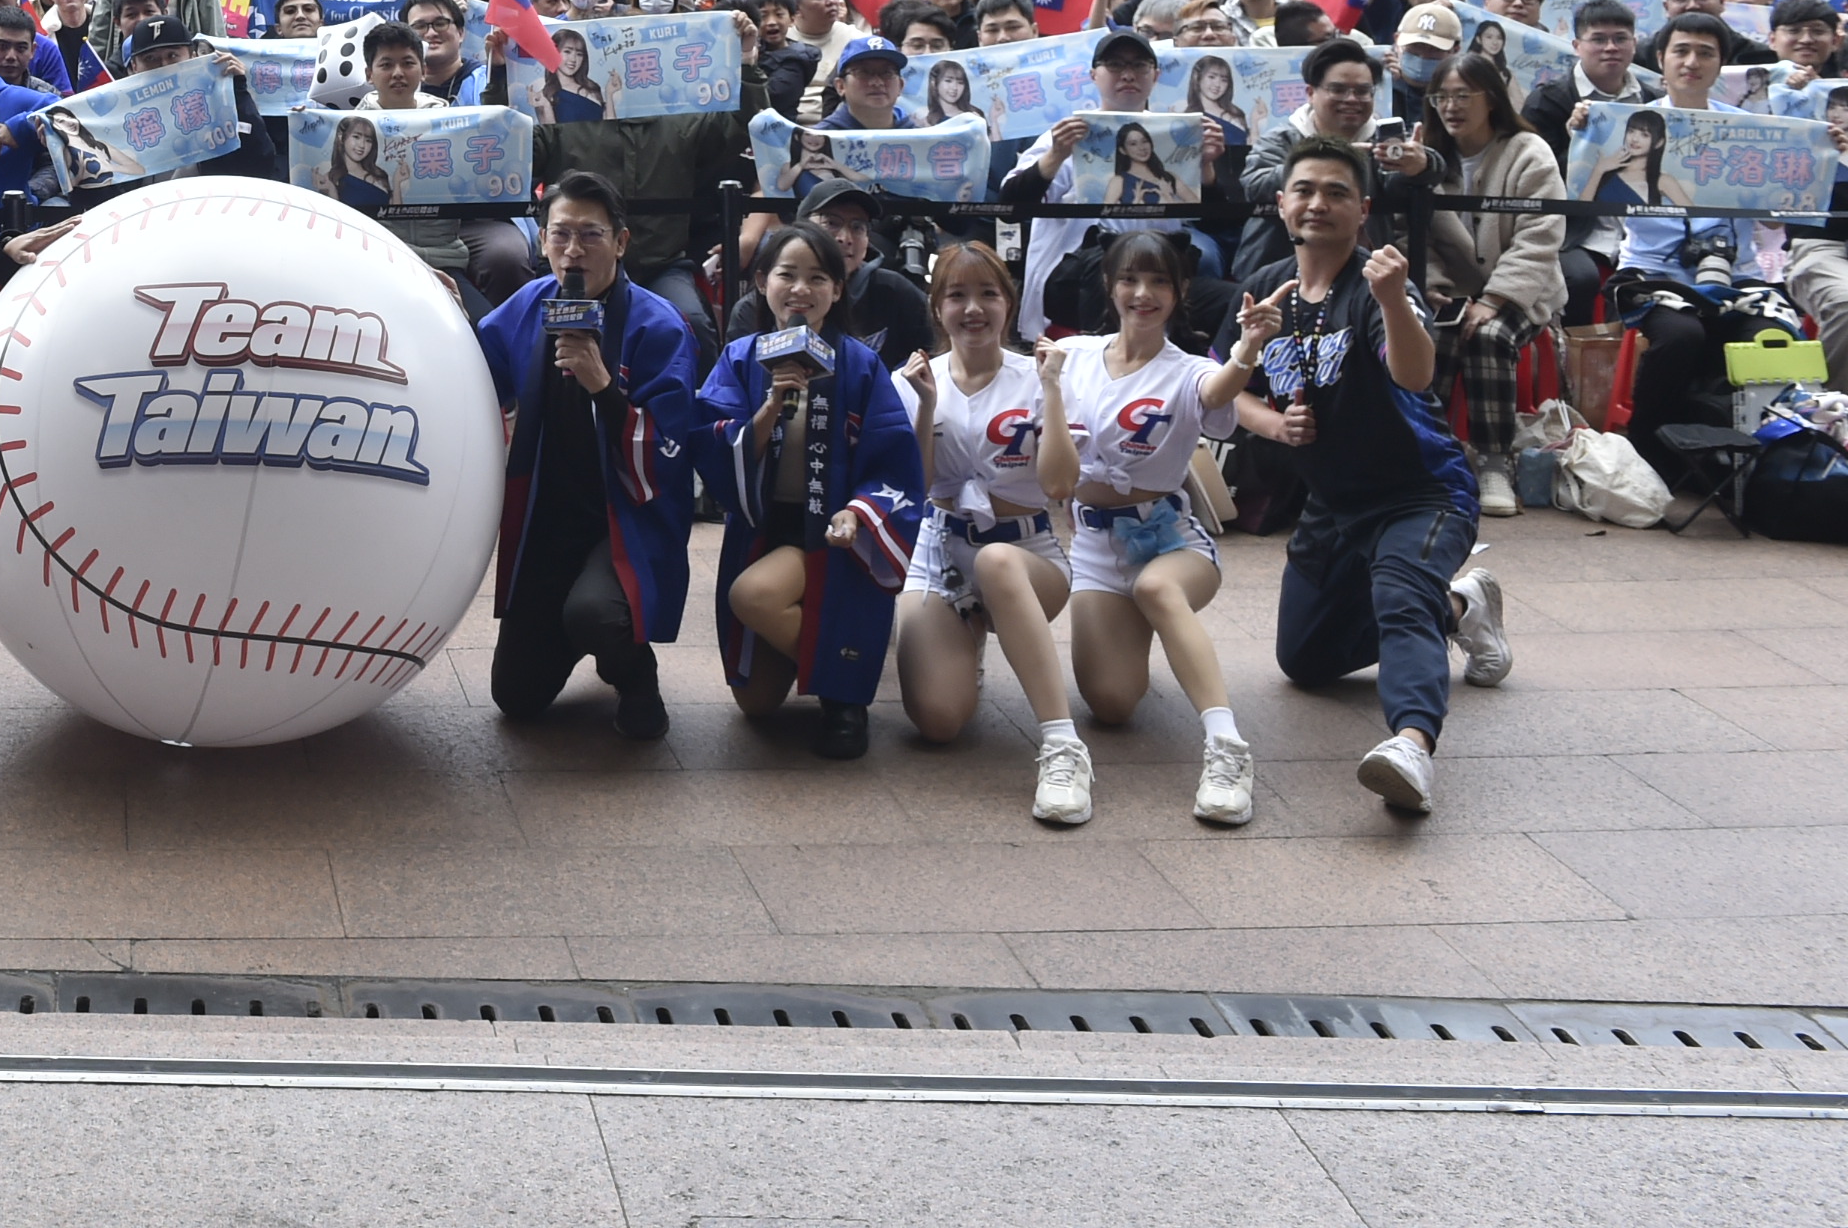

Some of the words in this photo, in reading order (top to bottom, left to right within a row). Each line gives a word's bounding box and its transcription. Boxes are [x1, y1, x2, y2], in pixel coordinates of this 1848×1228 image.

[648, 25, 680, 41] KURI
[623, 42, 713, 89] 栗子
[135, 78, 174, 103] LEMON
[697, 78, 731, 105] 90
[1004, 61, 1095, 113] 栗子
[123, 89, 212, 152] 檸檬
[203, 120, 236, 150] 100
[441, 117, 470, 131] KURI
[413, 135, 504, 178] 栗子
[875, 141, 969, 182] 奶昔
[1682, 145, 1816, 190] 卡洛琳
[487, 174, 522, 198] 90
[134, 282, 409, 385] Team
[74, 369, 430, 486] Taiwan
[810, 393, 830, 431] 無懼
[993, 454, 1031, 463] Chinese
[1118, 440, 1157, 451] Chinese
[808, 441, 828, 516] 心中無敵
[995, 461, 1028, 470] Taipei
